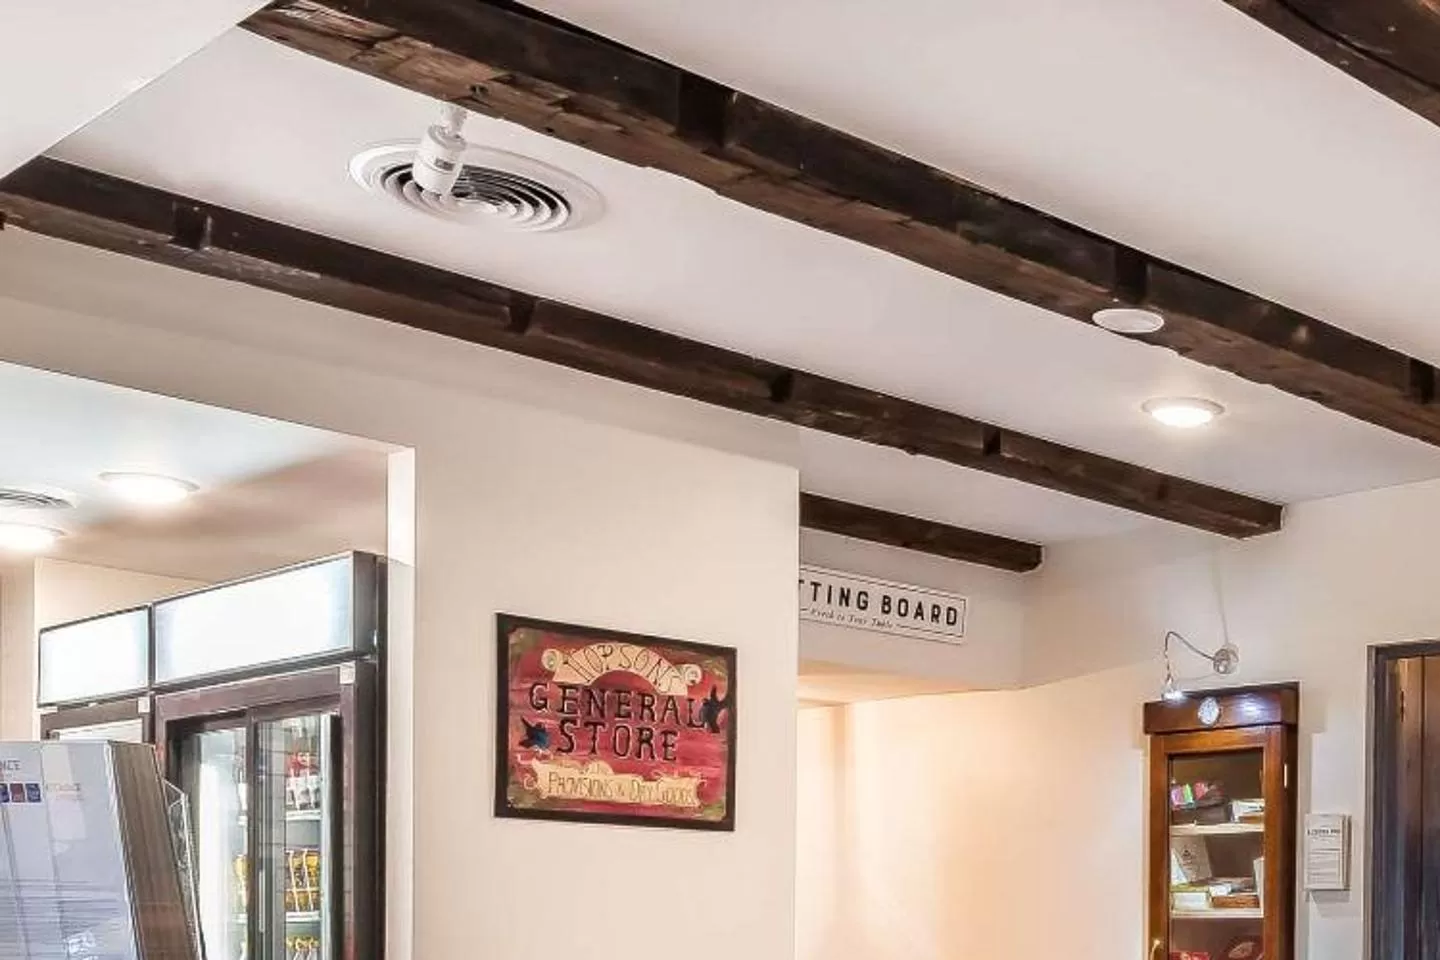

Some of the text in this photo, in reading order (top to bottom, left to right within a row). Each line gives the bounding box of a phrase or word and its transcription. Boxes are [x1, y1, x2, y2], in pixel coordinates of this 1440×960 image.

[881, 595, 957, 626] BOARD
[529, 682, 706, 729] GENERAL
[556, 718, 679, 762] STORE
